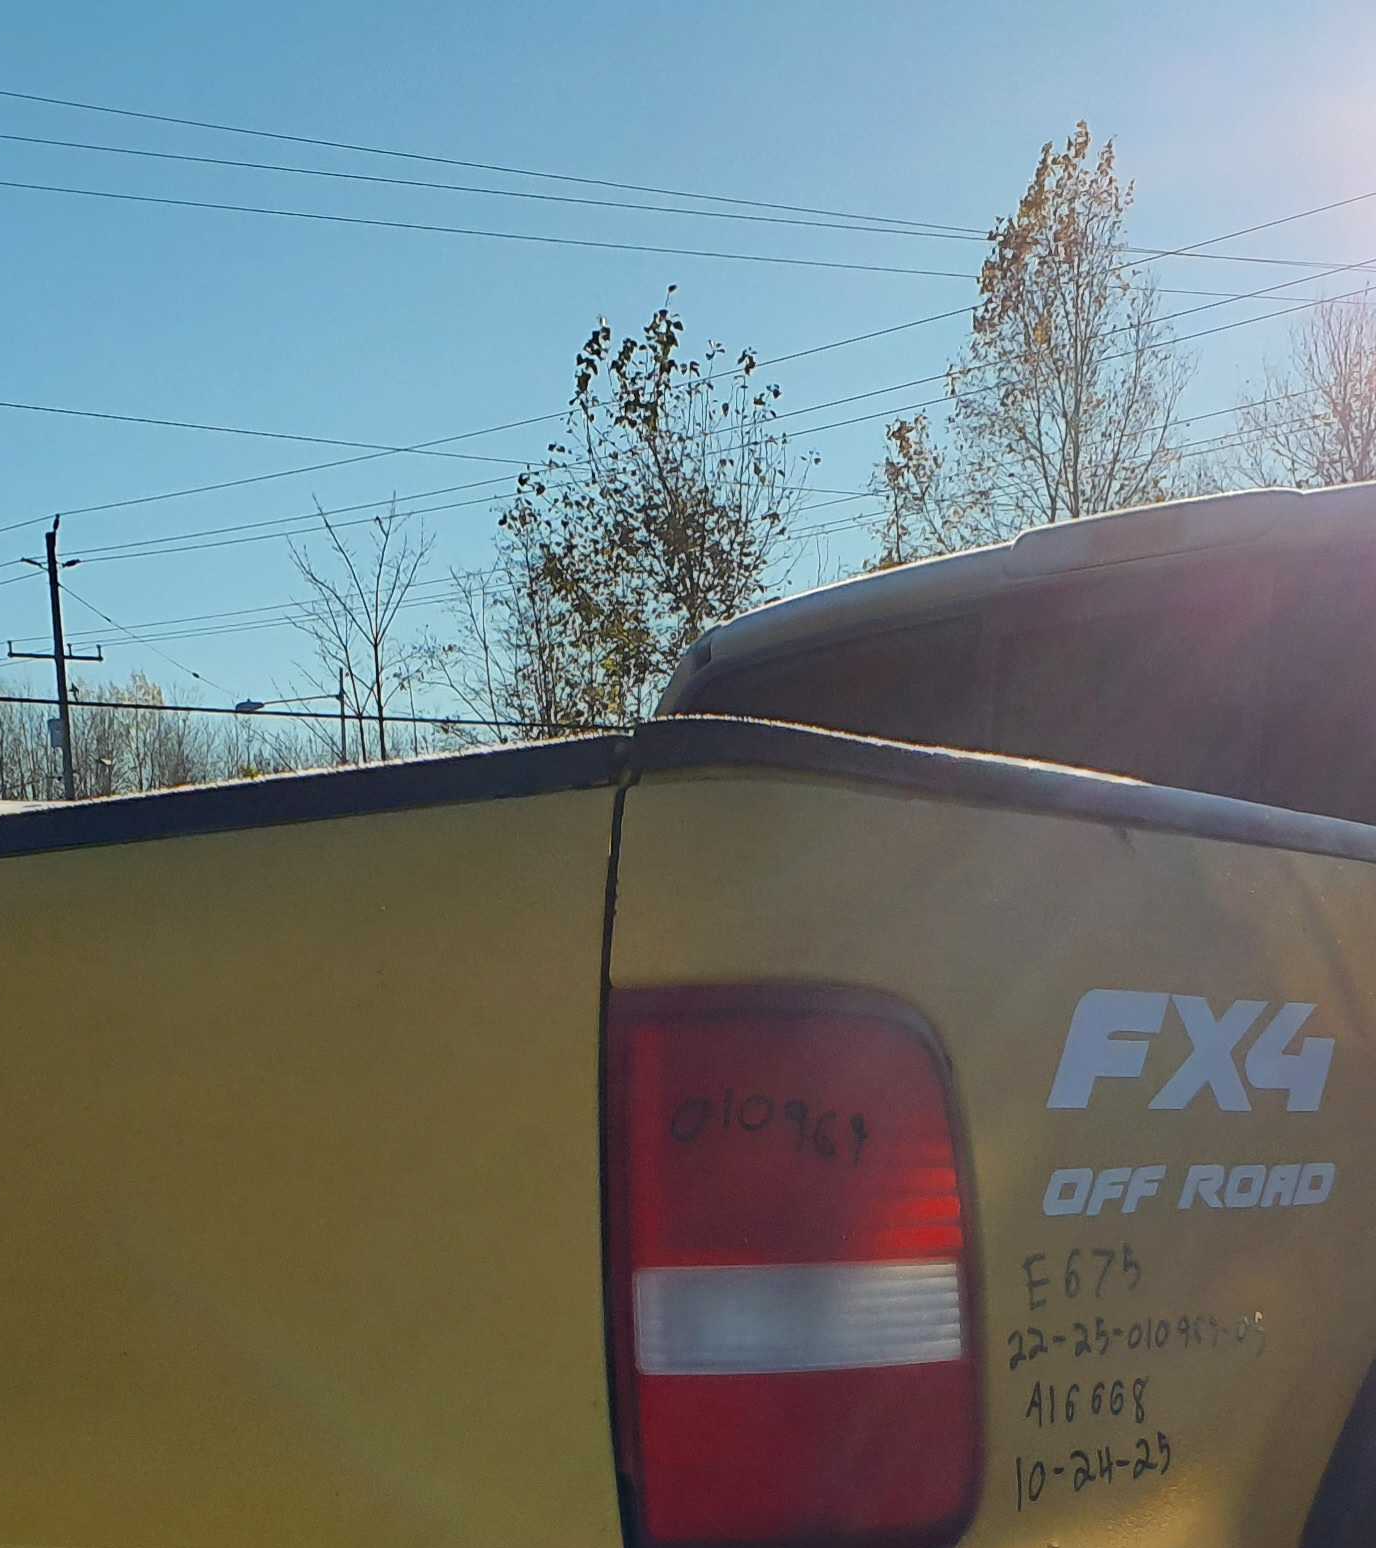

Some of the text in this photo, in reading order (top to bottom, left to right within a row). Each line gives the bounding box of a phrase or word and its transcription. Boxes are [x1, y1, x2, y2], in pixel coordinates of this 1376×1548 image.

[1046, 988, 1336, 1112] FX4
[1043, 1162, 1337, 1216] OFF ROAD
[1015, 1431, 1171, 1513] 10-24-25
